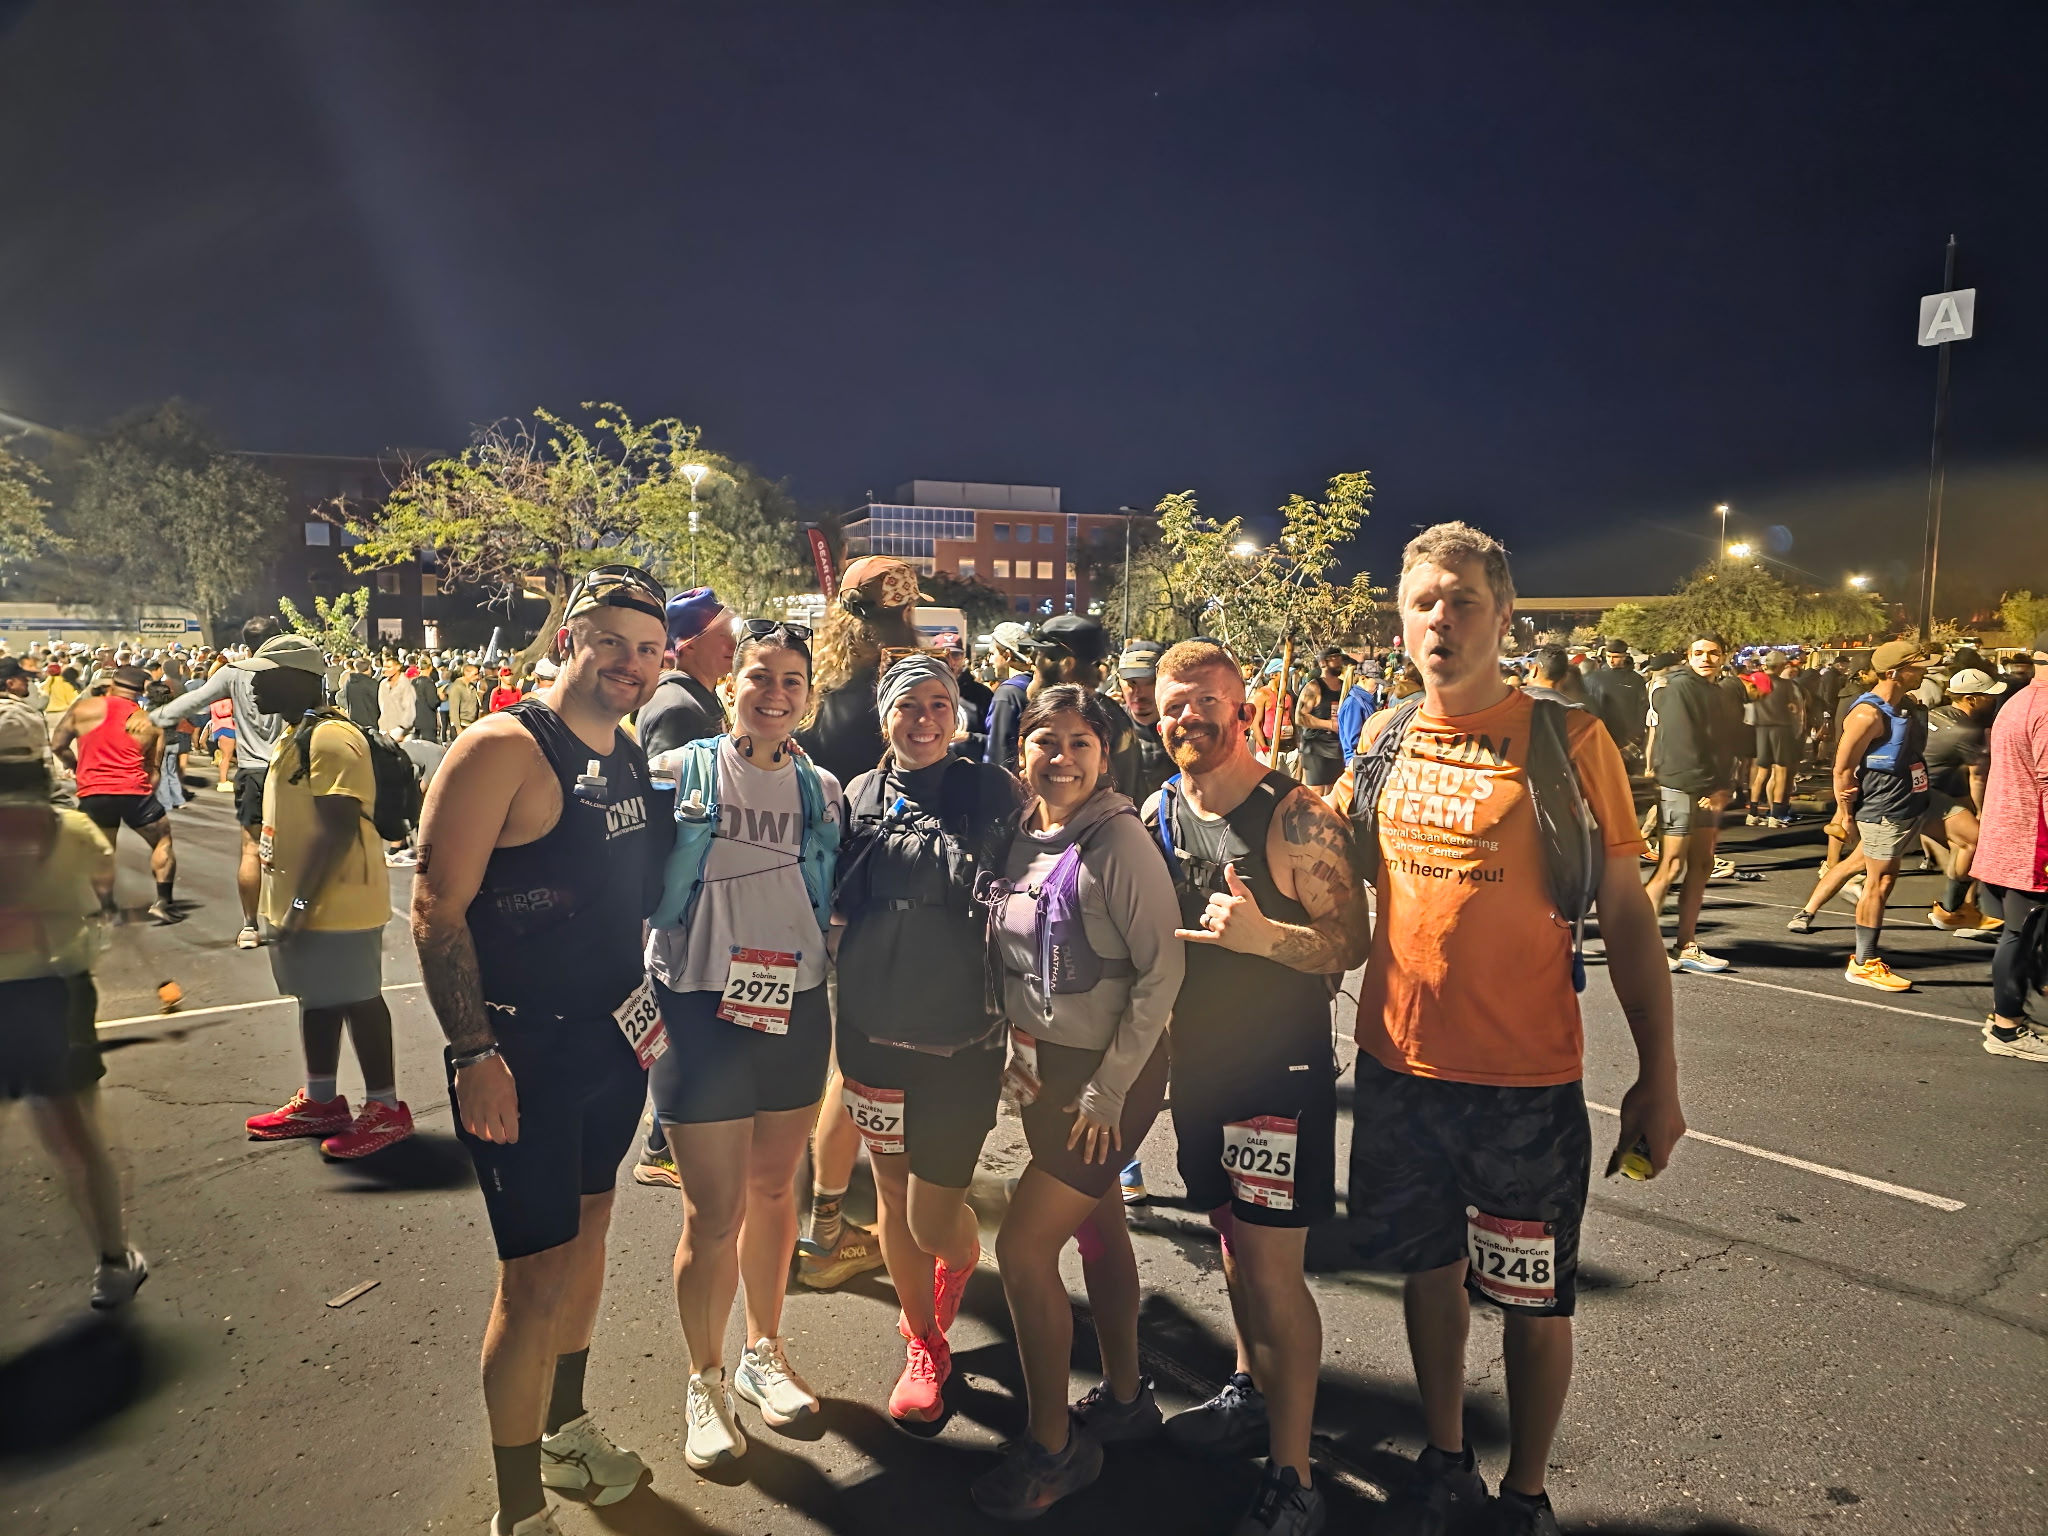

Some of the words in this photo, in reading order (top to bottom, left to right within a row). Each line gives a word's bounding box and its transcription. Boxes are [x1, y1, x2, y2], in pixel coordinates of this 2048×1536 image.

[1925, 297, 1966, 340] A
[817, 541, 830, 574] GEAR
[1386, 789, 1477, 832] TEAM
[1390, 838, 1426, 853] Cancer
[1426, 844, 1465, 860] Center
[1411, 829, 1440, 843] Sloan
[1441, 832, 1500, 852] Kettering
[1410, 859, 1453, 880] hear
[1458, 867, 1505, 885] you!
[752, 971, 777, 980] Sabrina
[1050, 944, 1060, 992] NATHAN
[727, 978, 790, 1005] 2975
[857, 1101, 883, 1114] LAUREN
[1246, 1137, 1268, 1147] CALEB
[1222, 1144, 1291, 1177] 3025
[840, 1246, 867, 1260] HOKA
[1473, 1234, 1550, 1256] KevinRunsForCure
[1474, 1244, 1551, 1284] 1248
